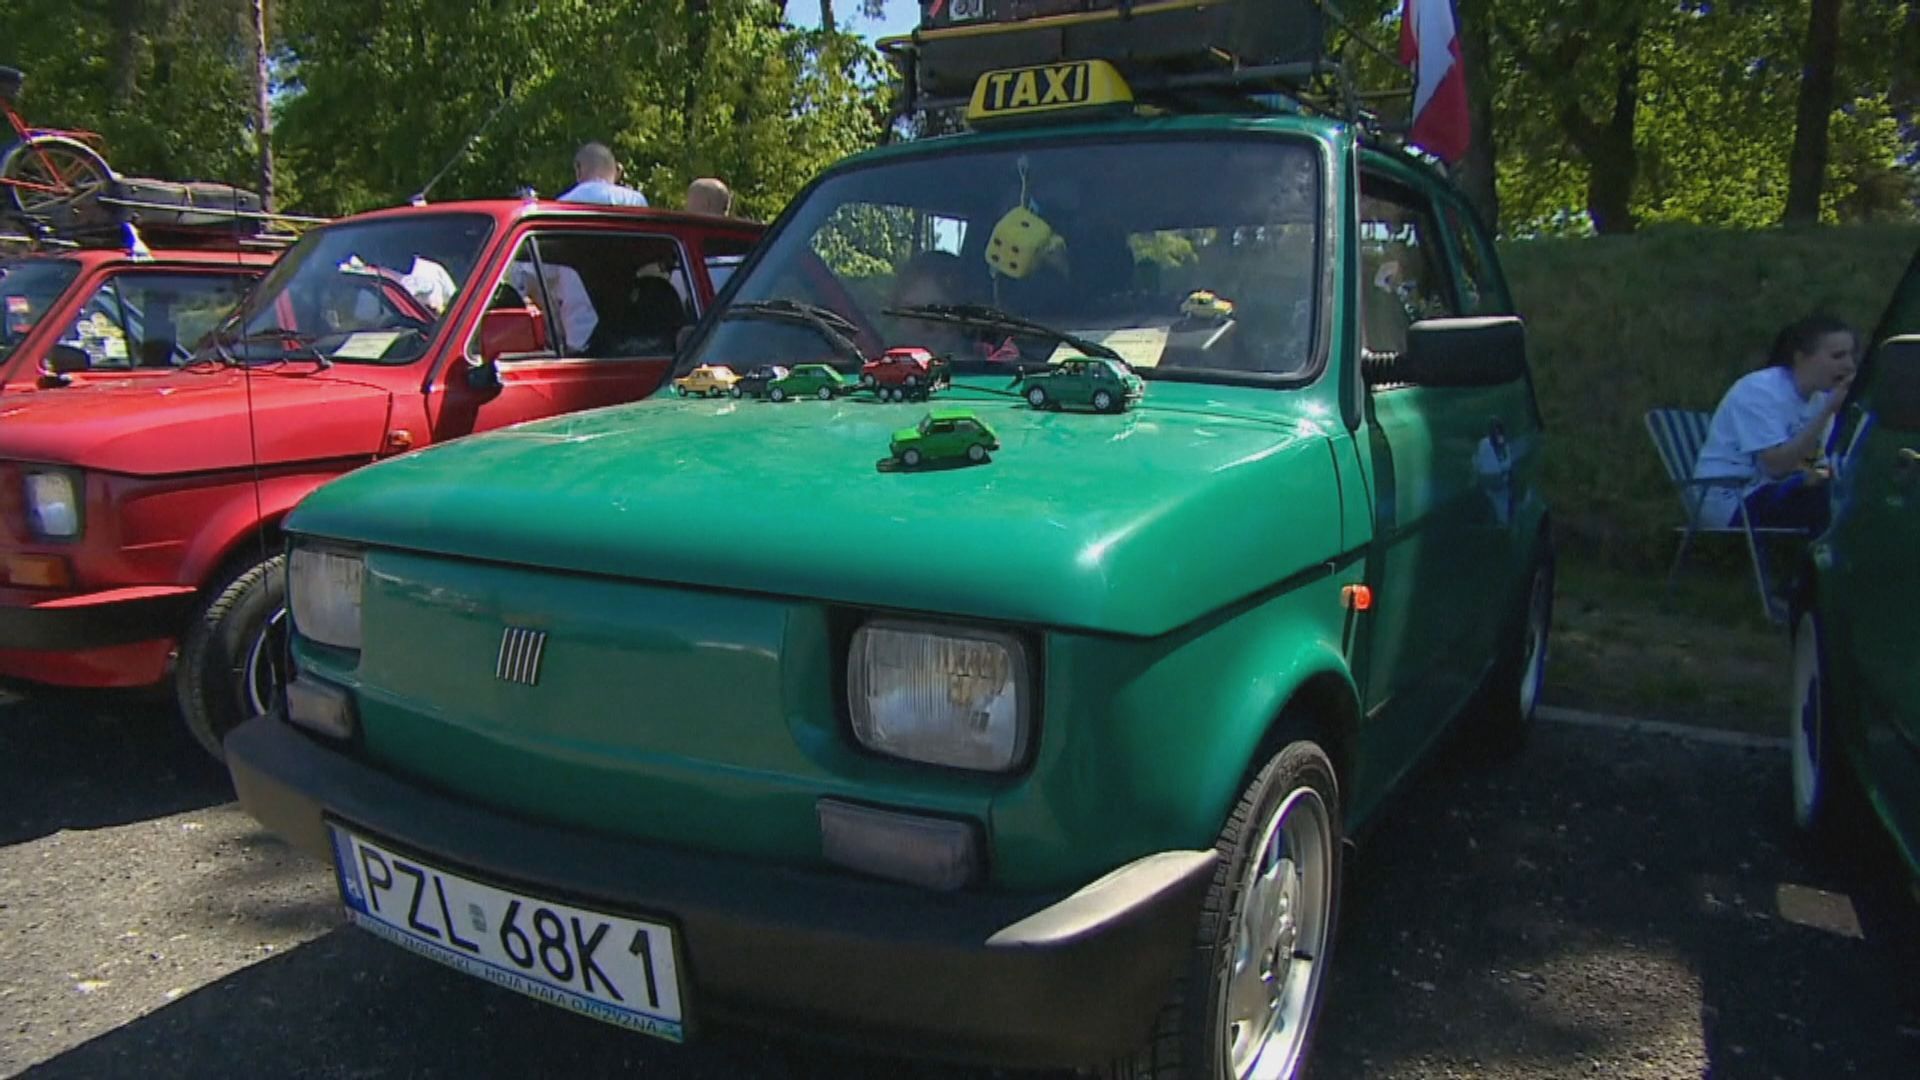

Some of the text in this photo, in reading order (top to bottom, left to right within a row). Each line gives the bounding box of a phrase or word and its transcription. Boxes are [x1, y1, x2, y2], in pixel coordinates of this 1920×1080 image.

[990, 64, 1086, 110] TAXI
[359, 845, 659, 1008] PZL 68K1
